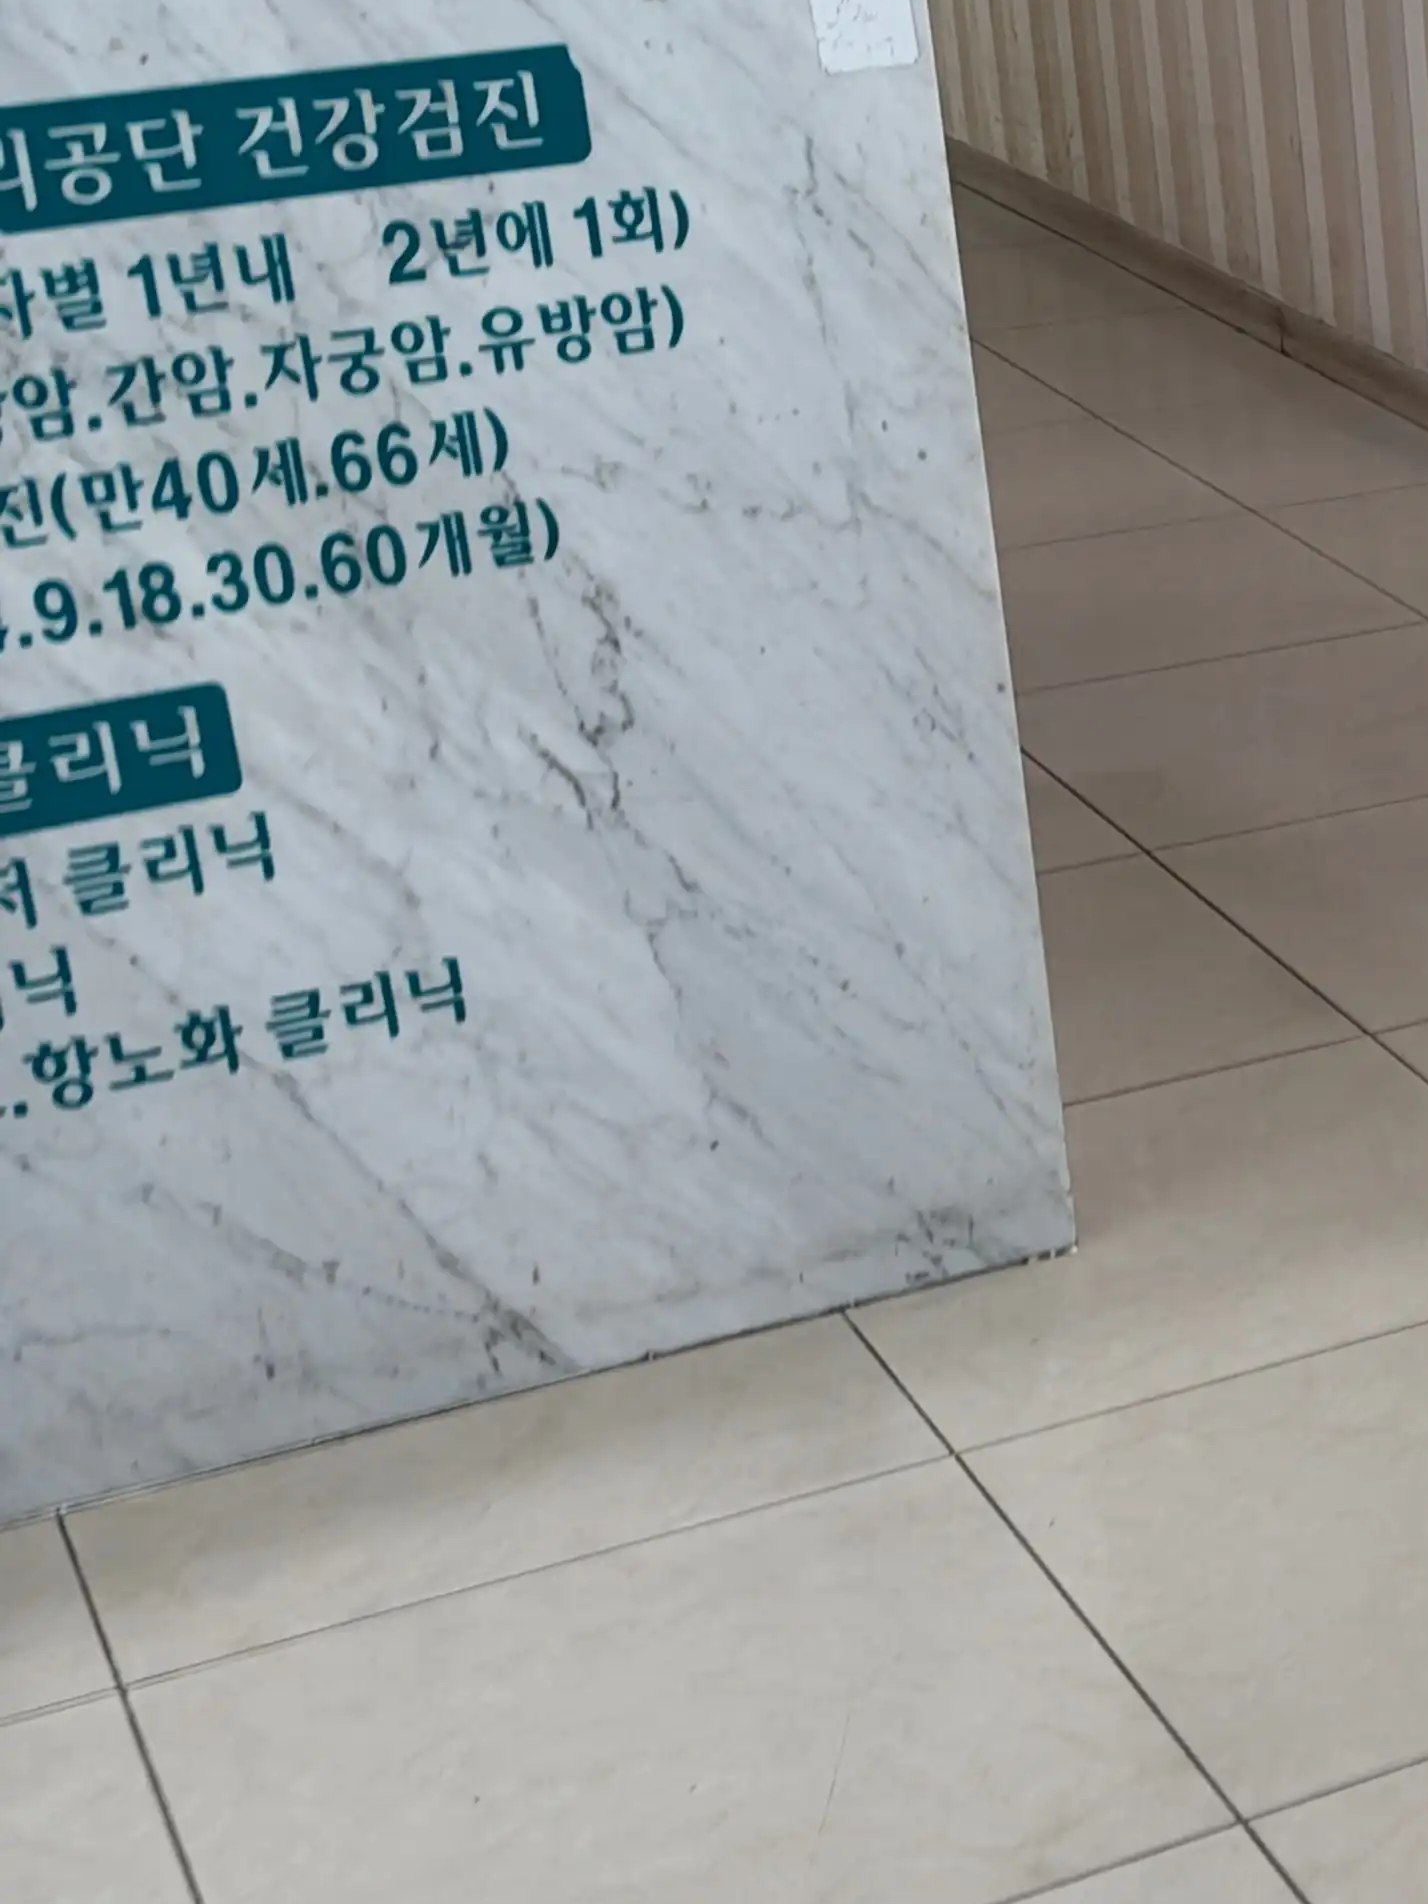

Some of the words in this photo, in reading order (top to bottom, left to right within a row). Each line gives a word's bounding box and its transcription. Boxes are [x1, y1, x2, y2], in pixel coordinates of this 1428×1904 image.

[236, 71, 544, 179] 건강검진
[126, 233, 296, 320] 1년내
[382, 200, 555, 285] 2년에
[571, 186, 690, 259] 1회)
[0, 284, 685, 443] 암.간암.자궁암.유방암)
[0, 407, 509, 549] 진(만40세.66세)
[0, 498, 560, 653] .9.18.30.60개월)
[63, 812, 276, 917] 클리닉
[0, 944, 77, 1032] 닉
[0, 1004, 242, 1117] .항노화
[267, 957, 467, 1060] 클리닉
